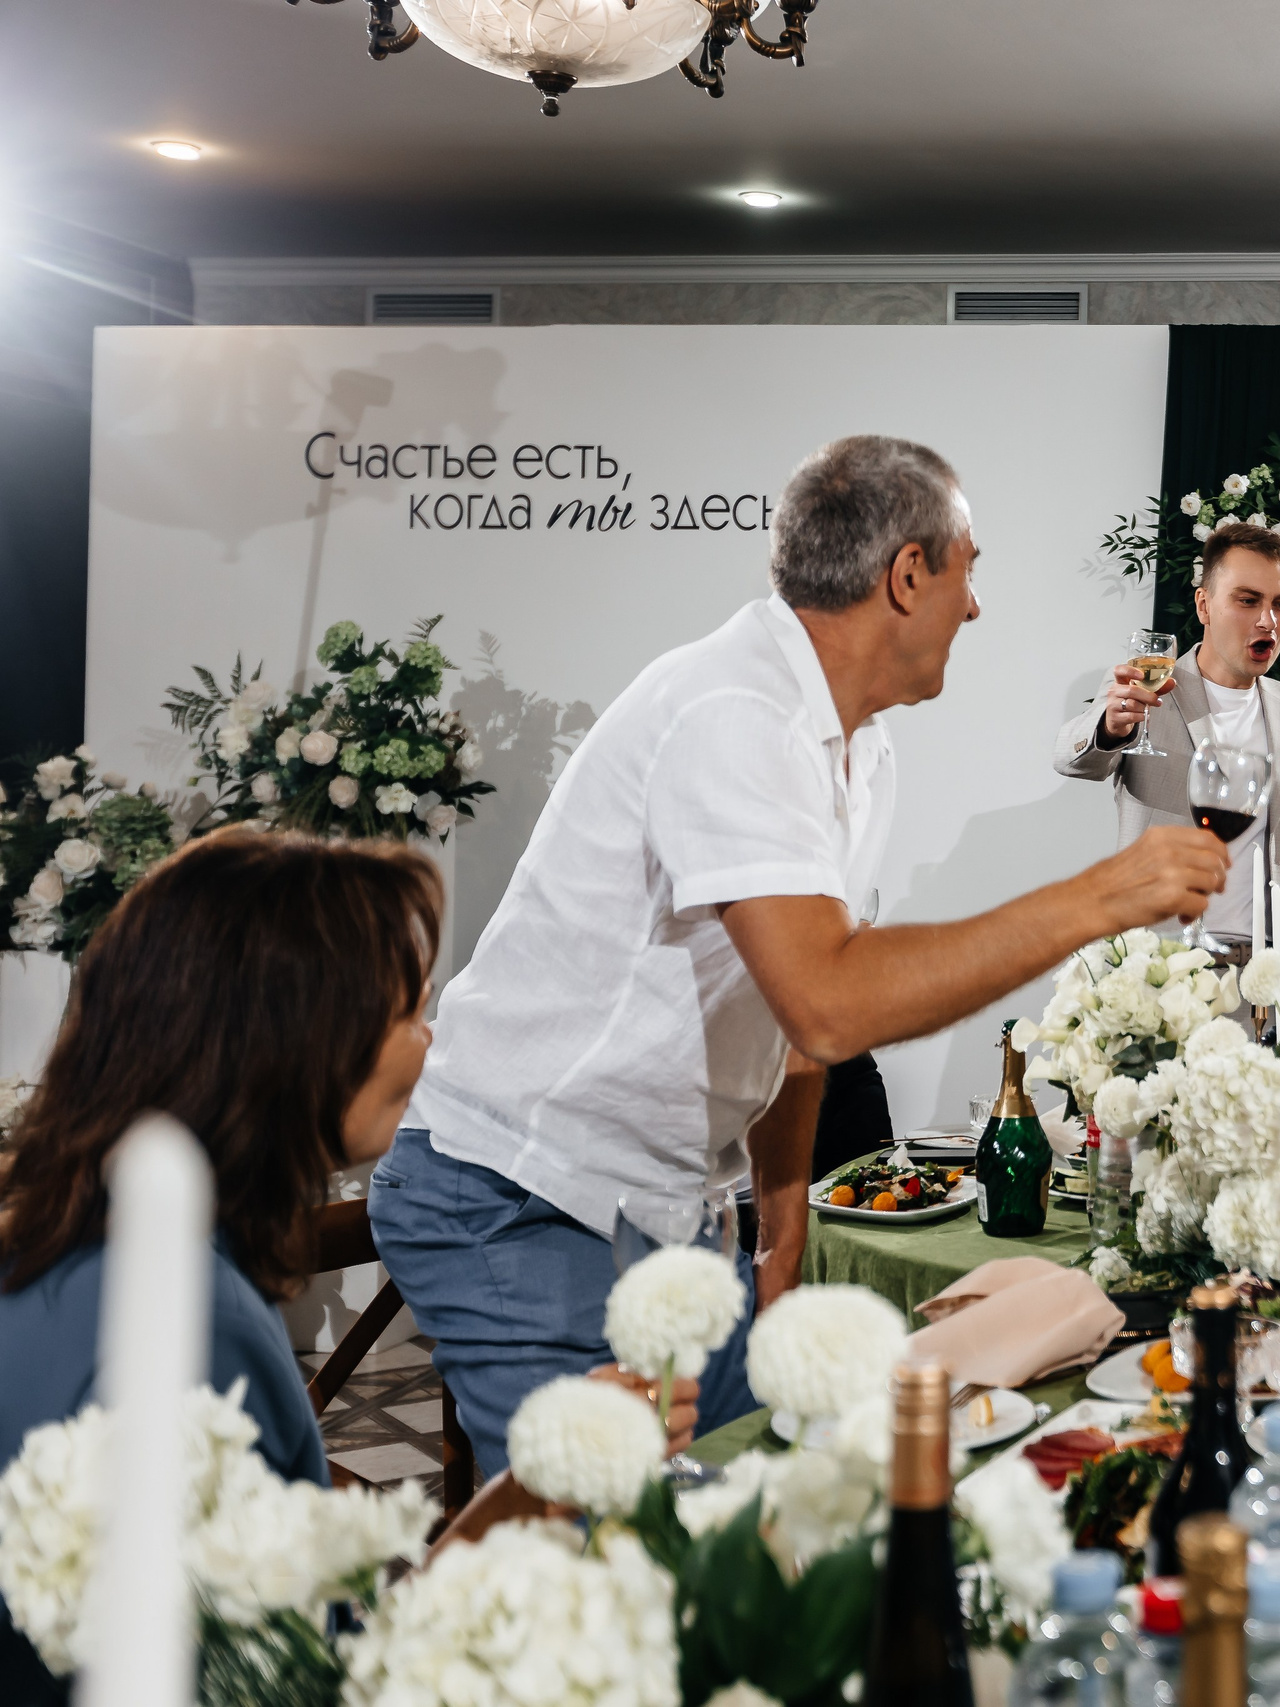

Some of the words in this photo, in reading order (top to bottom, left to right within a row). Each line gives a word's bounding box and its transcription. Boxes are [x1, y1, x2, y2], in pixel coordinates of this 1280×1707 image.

[305, 431, 497, 480] Счастье
[512, 444, 632, 491] есть,
[409, 494, 532, 530] когда
[546, 495, 636, 533] ты
